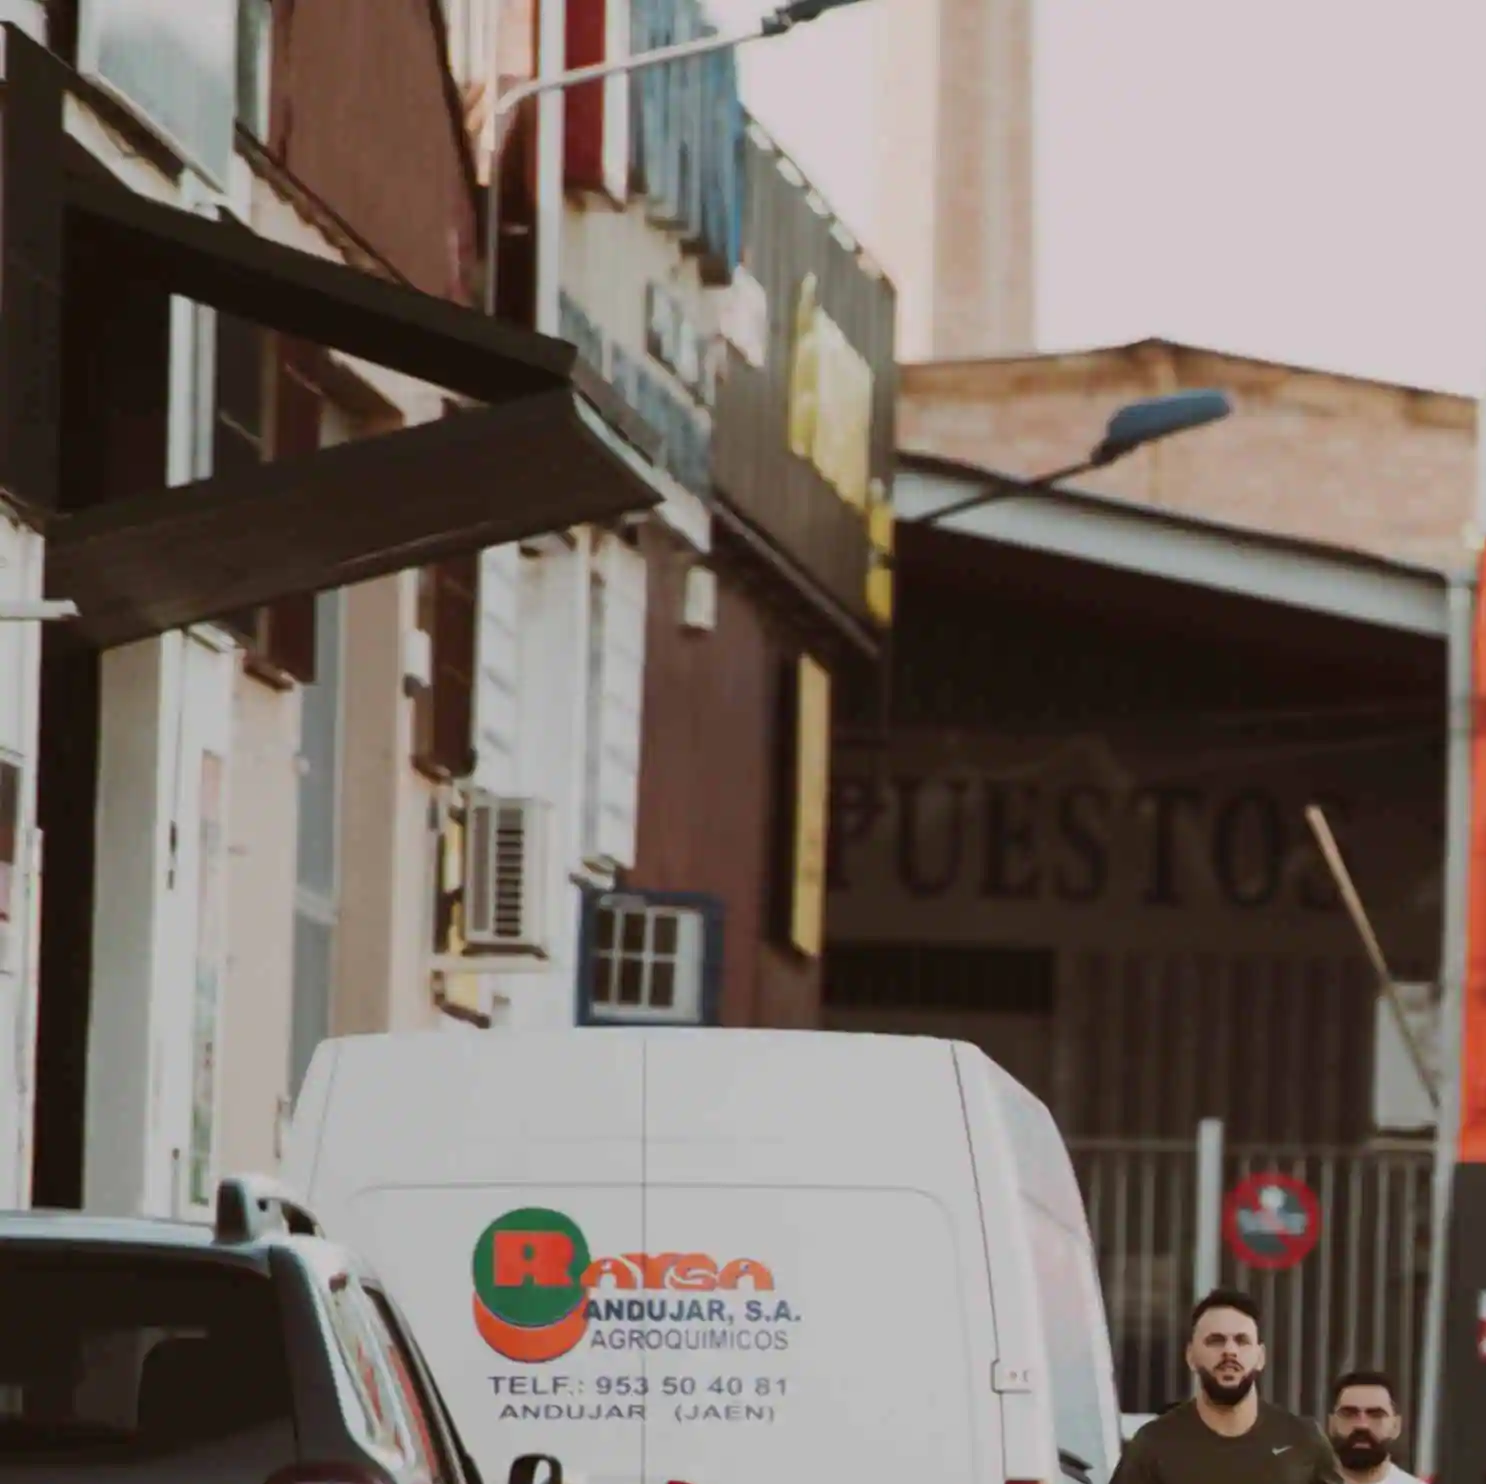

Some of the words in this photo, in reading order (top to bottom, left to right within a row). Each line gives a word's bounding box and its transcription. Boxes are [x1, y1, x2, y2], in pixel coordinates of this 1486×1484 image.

[583, 1300, 734, 1324] ANDUJAR,
[745, 1300, 802, 1323] S.A.
[590, 1328, 789, 1351] AGROQUIMICOS
[595, 1376, 649, 1396] 953
[662, 1376, 696, 1396] 50
[707, 1376, 743, 1396] 40
[755, 1376, 788, 1396] 81
[499, 1403, 646, 1421] ANDUJAR
